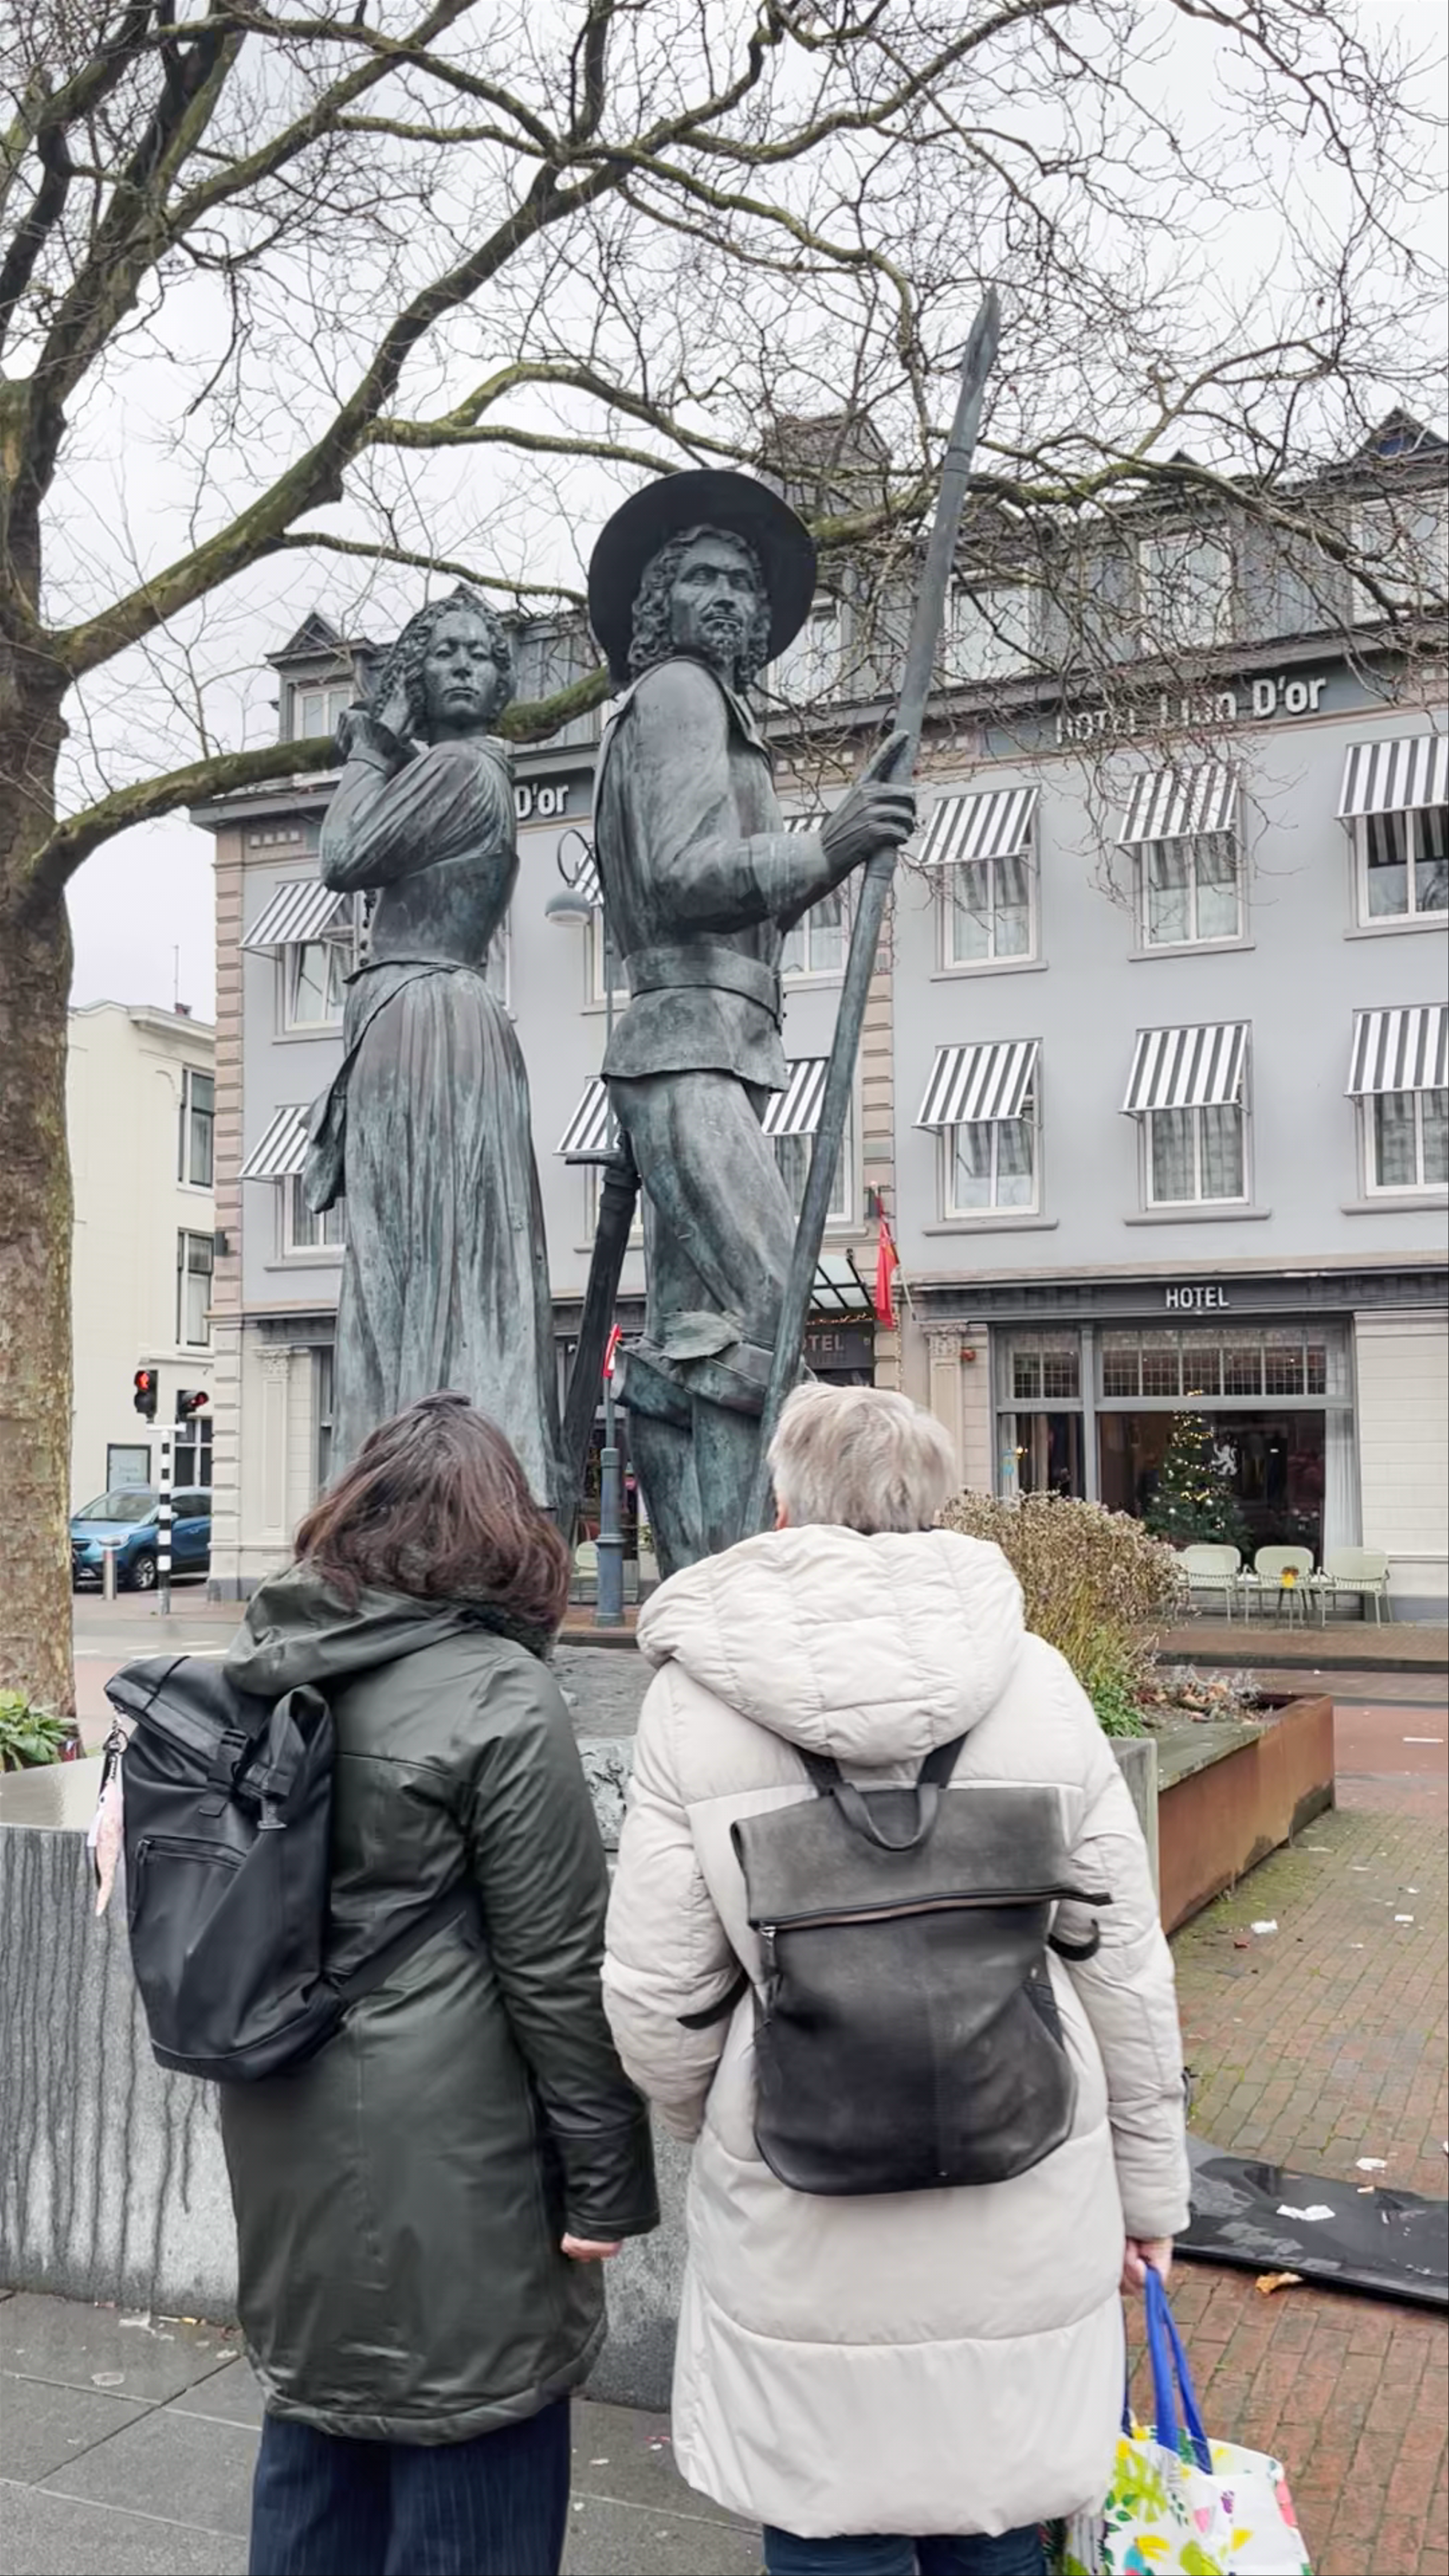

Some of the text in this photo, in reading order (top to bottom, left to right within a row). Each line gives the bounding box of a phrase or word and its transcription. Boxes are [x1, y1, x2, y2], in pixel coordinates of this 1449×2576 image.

[1253, 675, 1326, 717] D'or
[514, 783, 569, 818] D'or
[1166, 1287, 1229, 1308] HOTEL
[802, 1335, 844, 1351] TEL
